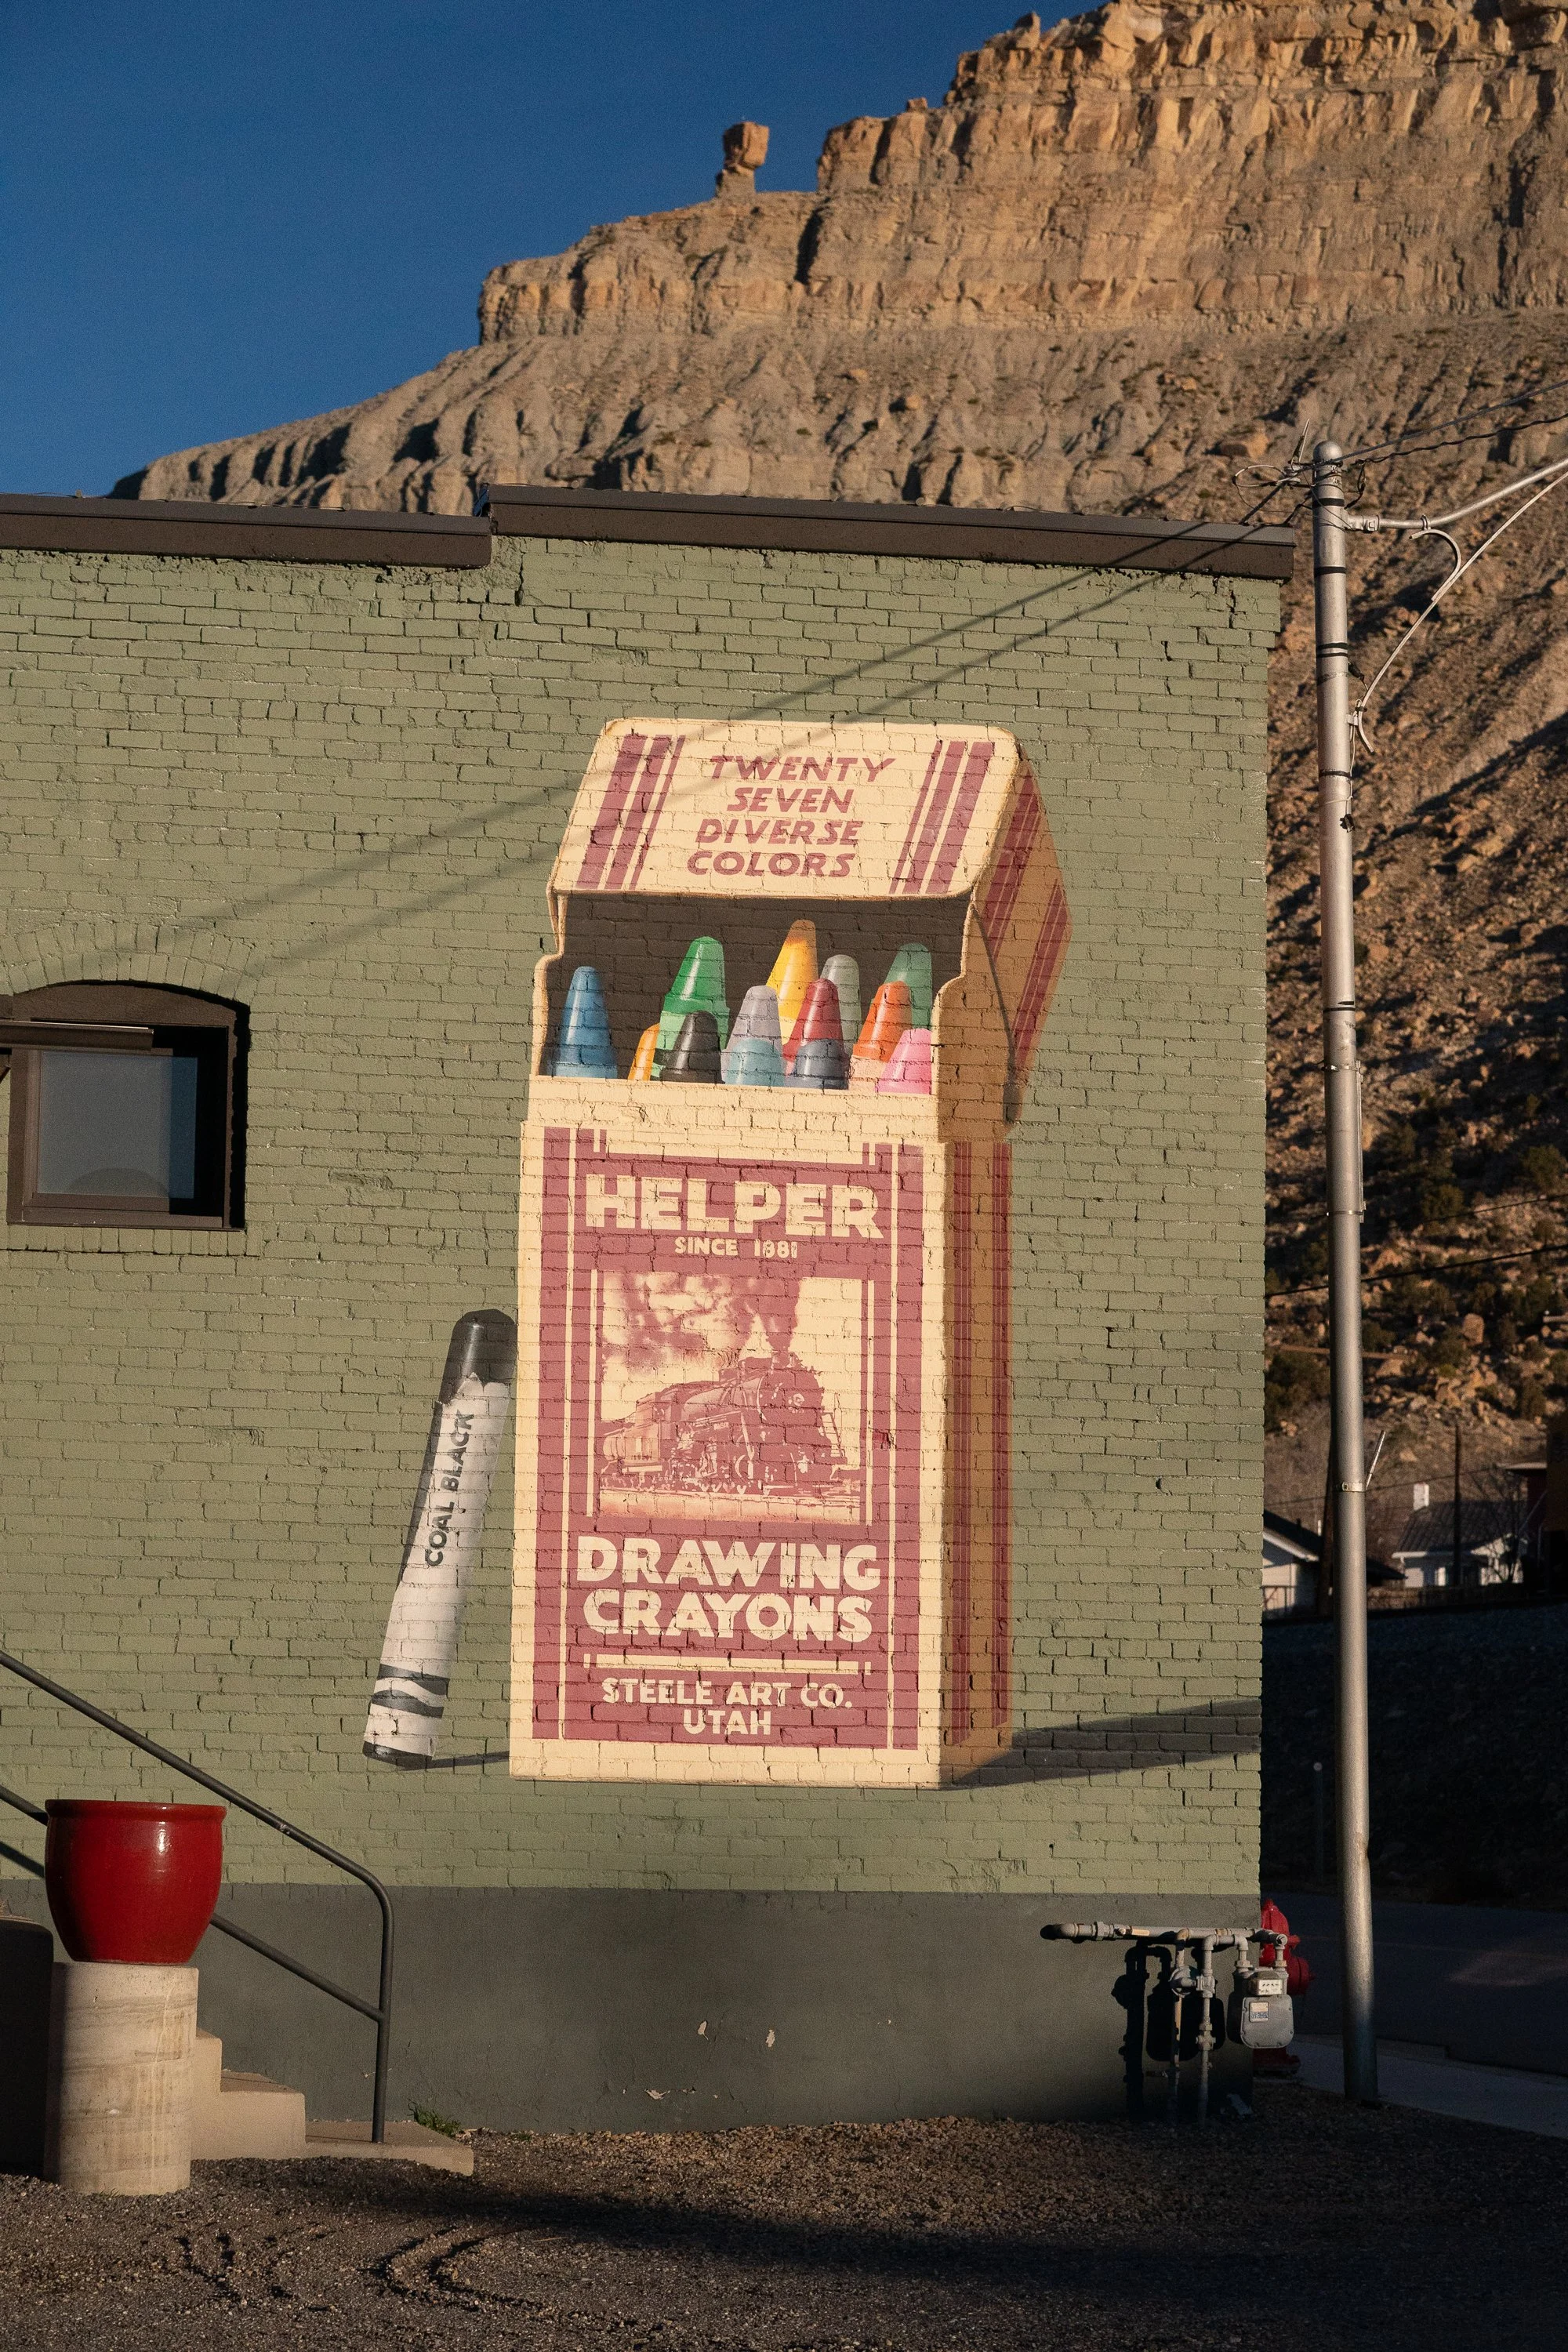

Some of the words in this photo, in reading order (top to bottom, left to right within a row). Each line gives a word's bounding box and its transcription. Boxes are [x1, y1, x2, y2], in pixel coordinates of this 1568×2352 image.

[710, 756, 895, 782] TWENTY
[727, 788, 855, 813] SEVEN
[697, 819, 863, 845] DIVERSE
[687, 851, 856, 877] COLORS
[586, 1174, 884, 1239] HELPER
[675, 1237, 738, 1257] SINCE
[754, 1239, 797, 1258] 1881
[424, 1501, 455, 1566] COAL
[440, 1409, 474, 1491] BLACK
[576, 1537, 880, 1591] DRAWING
[583, 1588, 873, 1642] CRAYONS
[602, 1677, 713, 1705] STEELE
[726, 1681, 791, 1707] ART
[800, 1682, 852, 1709] CO.
[683, 1709, 771, 1735] UTAH
